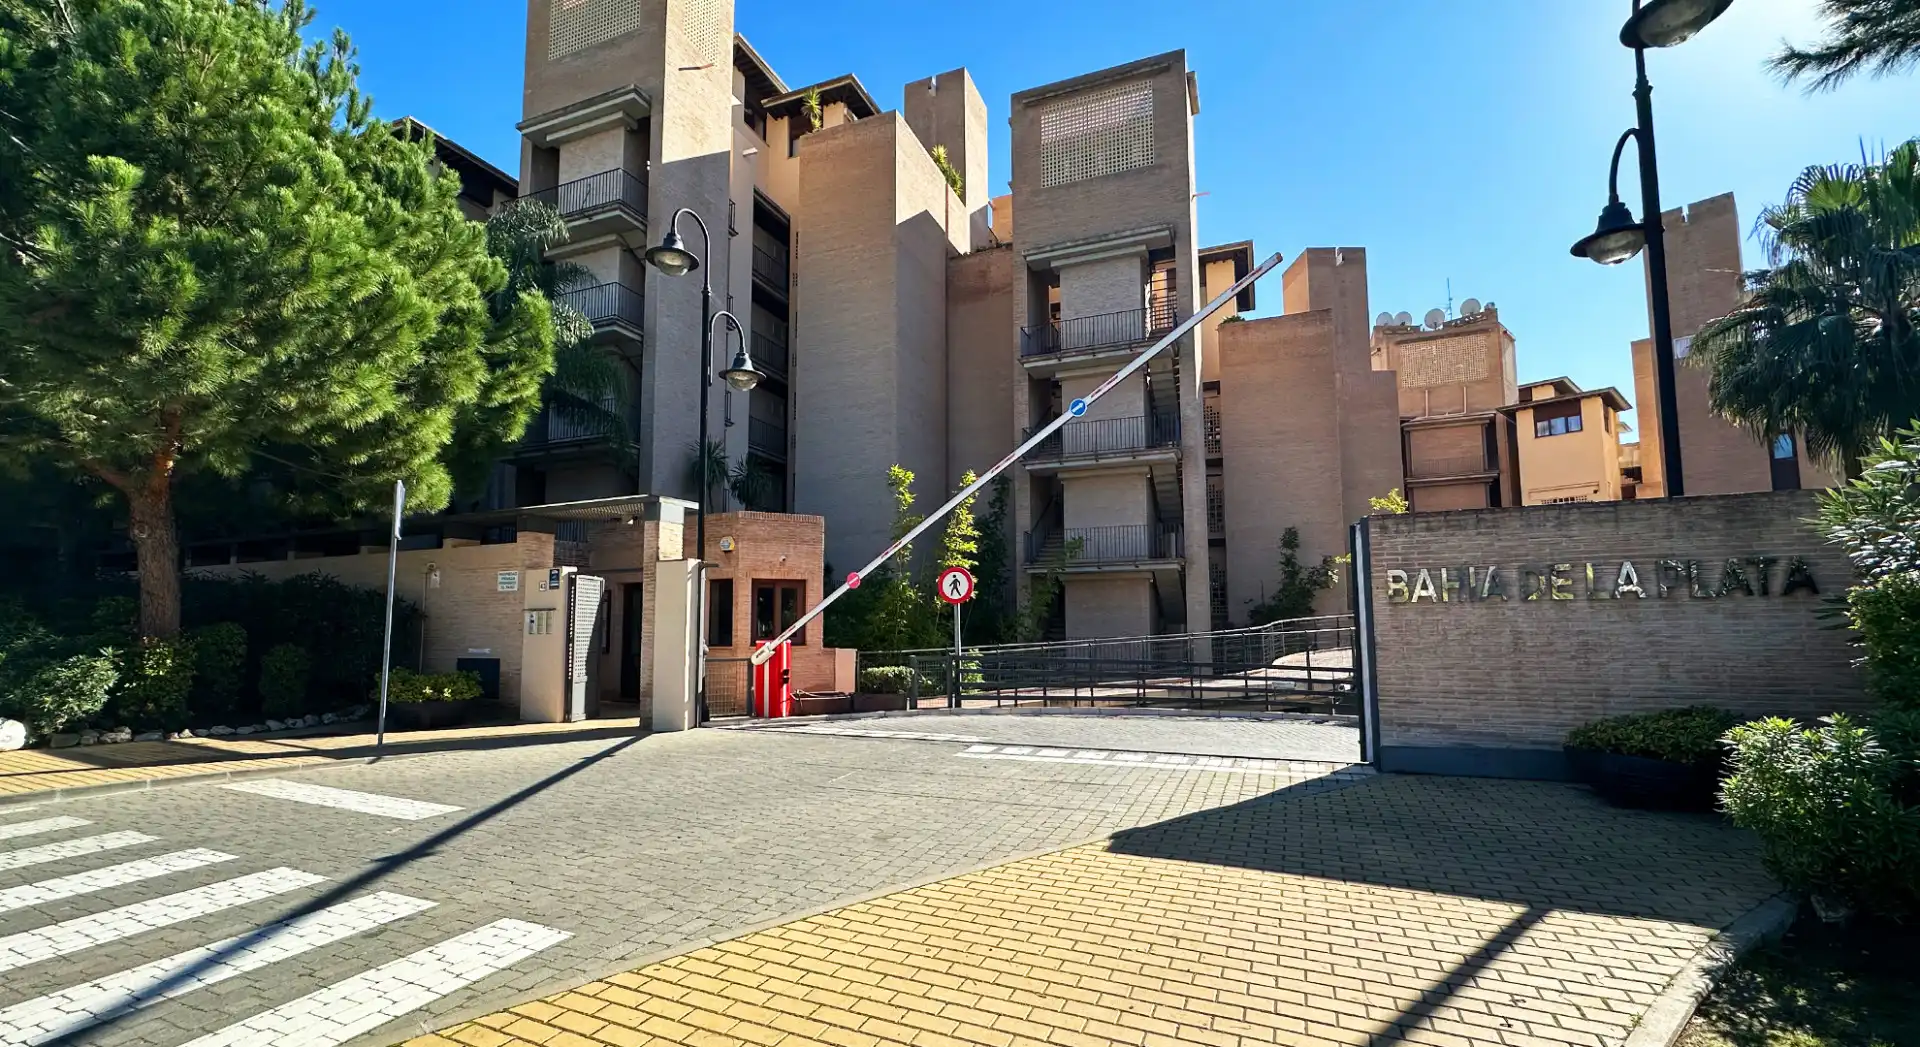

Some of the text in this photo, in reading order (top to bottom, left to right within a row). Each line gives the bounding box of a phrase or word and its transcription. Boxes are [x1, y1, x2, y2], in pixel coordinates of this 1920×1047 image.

[1386, 555, 1821, 603] BAHIA DE LA PLATA
